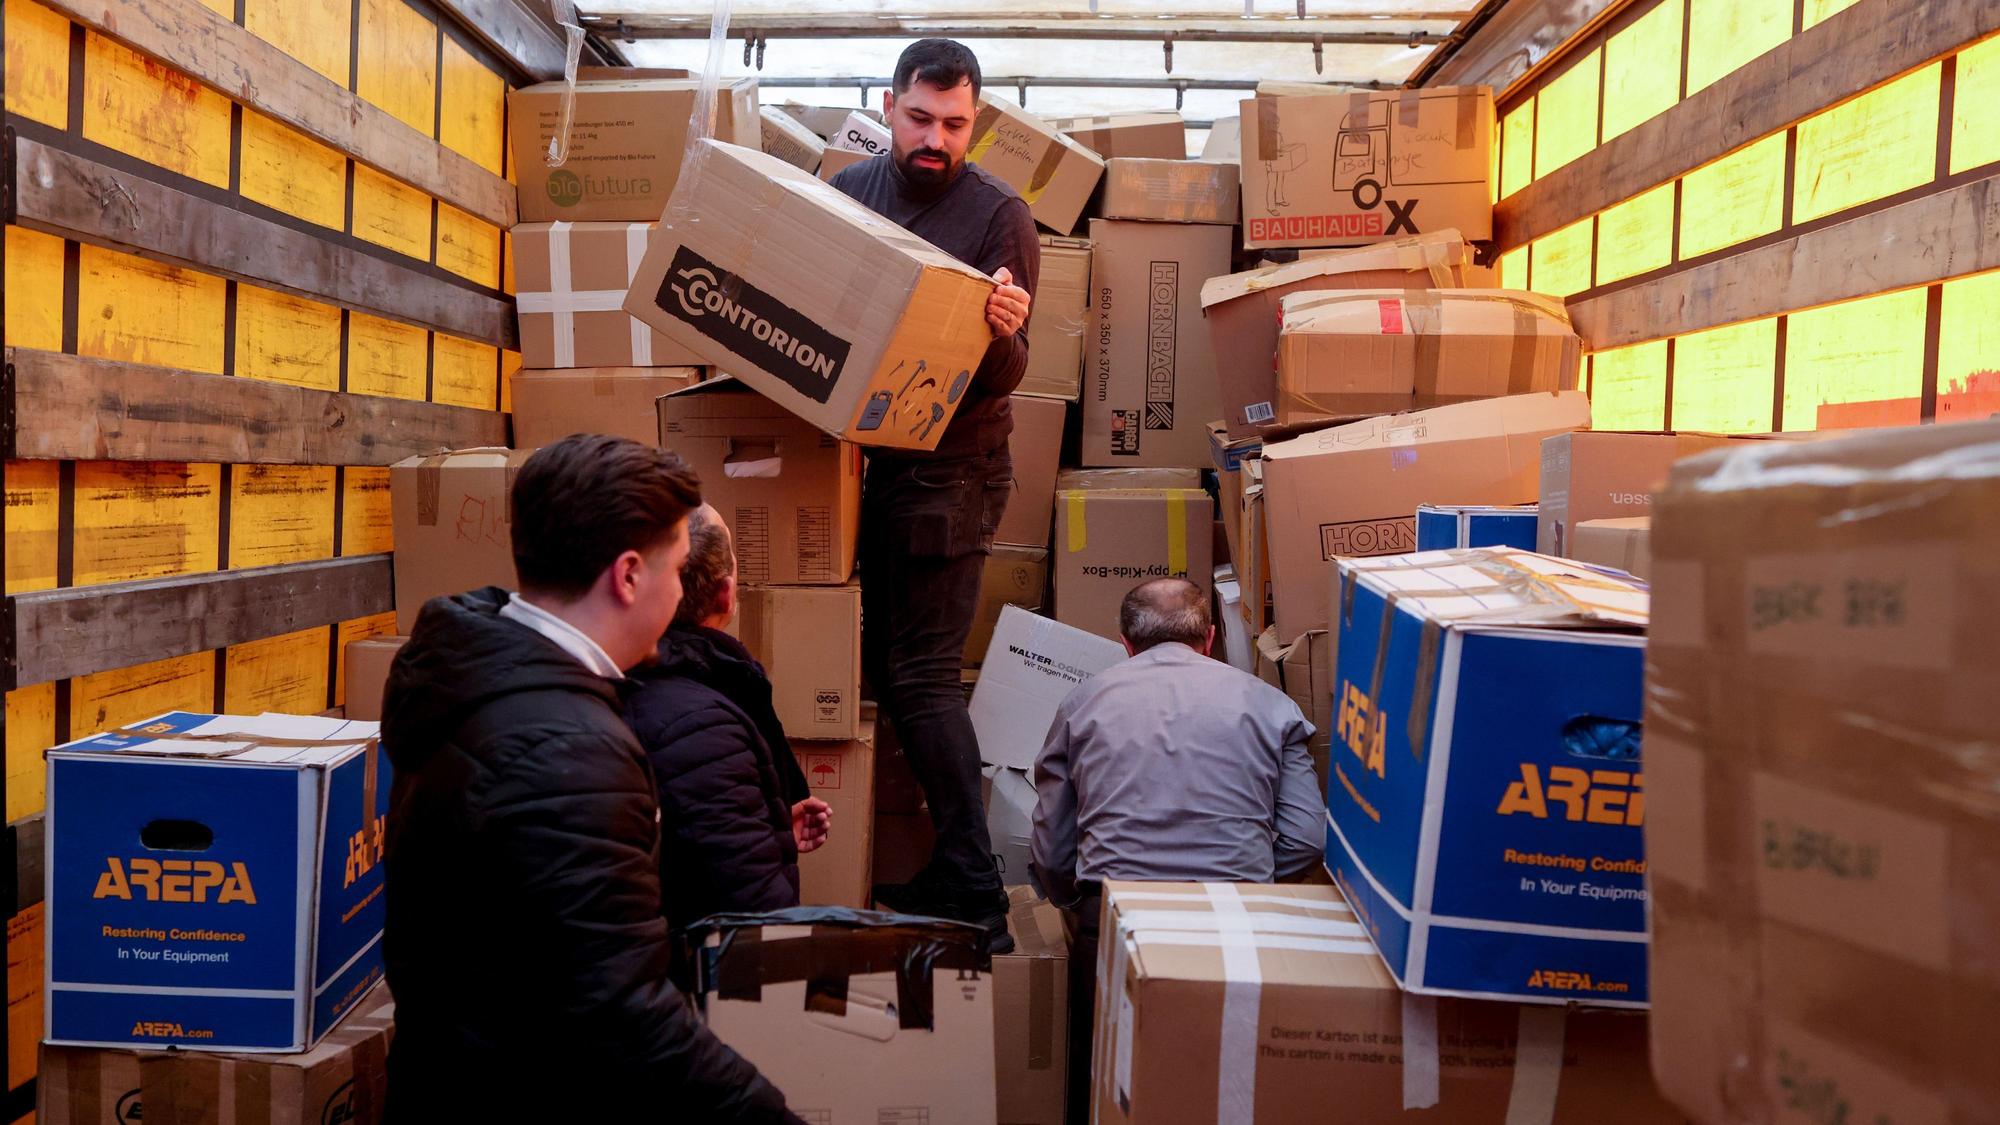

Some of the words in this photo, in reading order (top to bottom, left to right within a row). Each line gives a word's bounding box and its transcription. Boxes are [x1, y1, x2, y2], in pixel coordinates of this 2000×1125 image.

[1251, 213, 1382, 241] BAUHAUS
[1100, 287, 1112, 310] 650
[688, 279, 836, 380] CONTORION
[1100, 323, 1112, 344] 350
[1150, 265, 1175, 400] HORNBACH
[1098, 358, 1111, 402] 370mm
[1124, 410, 1139, 450] CARGO
[1082, 563, 1188, 579] Hppy-Kids-Box
[1023, 658, 1037, 669] Wir
[1037, 664, 1062, 678] tragen
[1503, 848, 1586, 872] Restoring
[92, 856, 258, 905] AREPA
[1519, 877, 1536, 892] In
[1540, 879, 1576, 897] Your
[102, 925, 167, 942] Restoring
[169, 928, 246, 942] Confidence
[117, 948, 130, 960] In
[132, 948, 161, 961] Your
[162, 950, 230, 964] Equipment
[1526, 969, 1629, 994] AREPA.com
[131, 1021, 214, 1040] AREPA.com
[1271, 1026, 1312, 1041] Dieser
[1315, 1029, 1360, 1044] Karton
[1362, 1031, 1379, 1044] ist
[1260, 1044, 1286, 1058] This
[1288, 1049, 1331, 1061] carton
[1334, 1050, 1345, 1061] is
[1347, 1051, 1386, 1063] made
